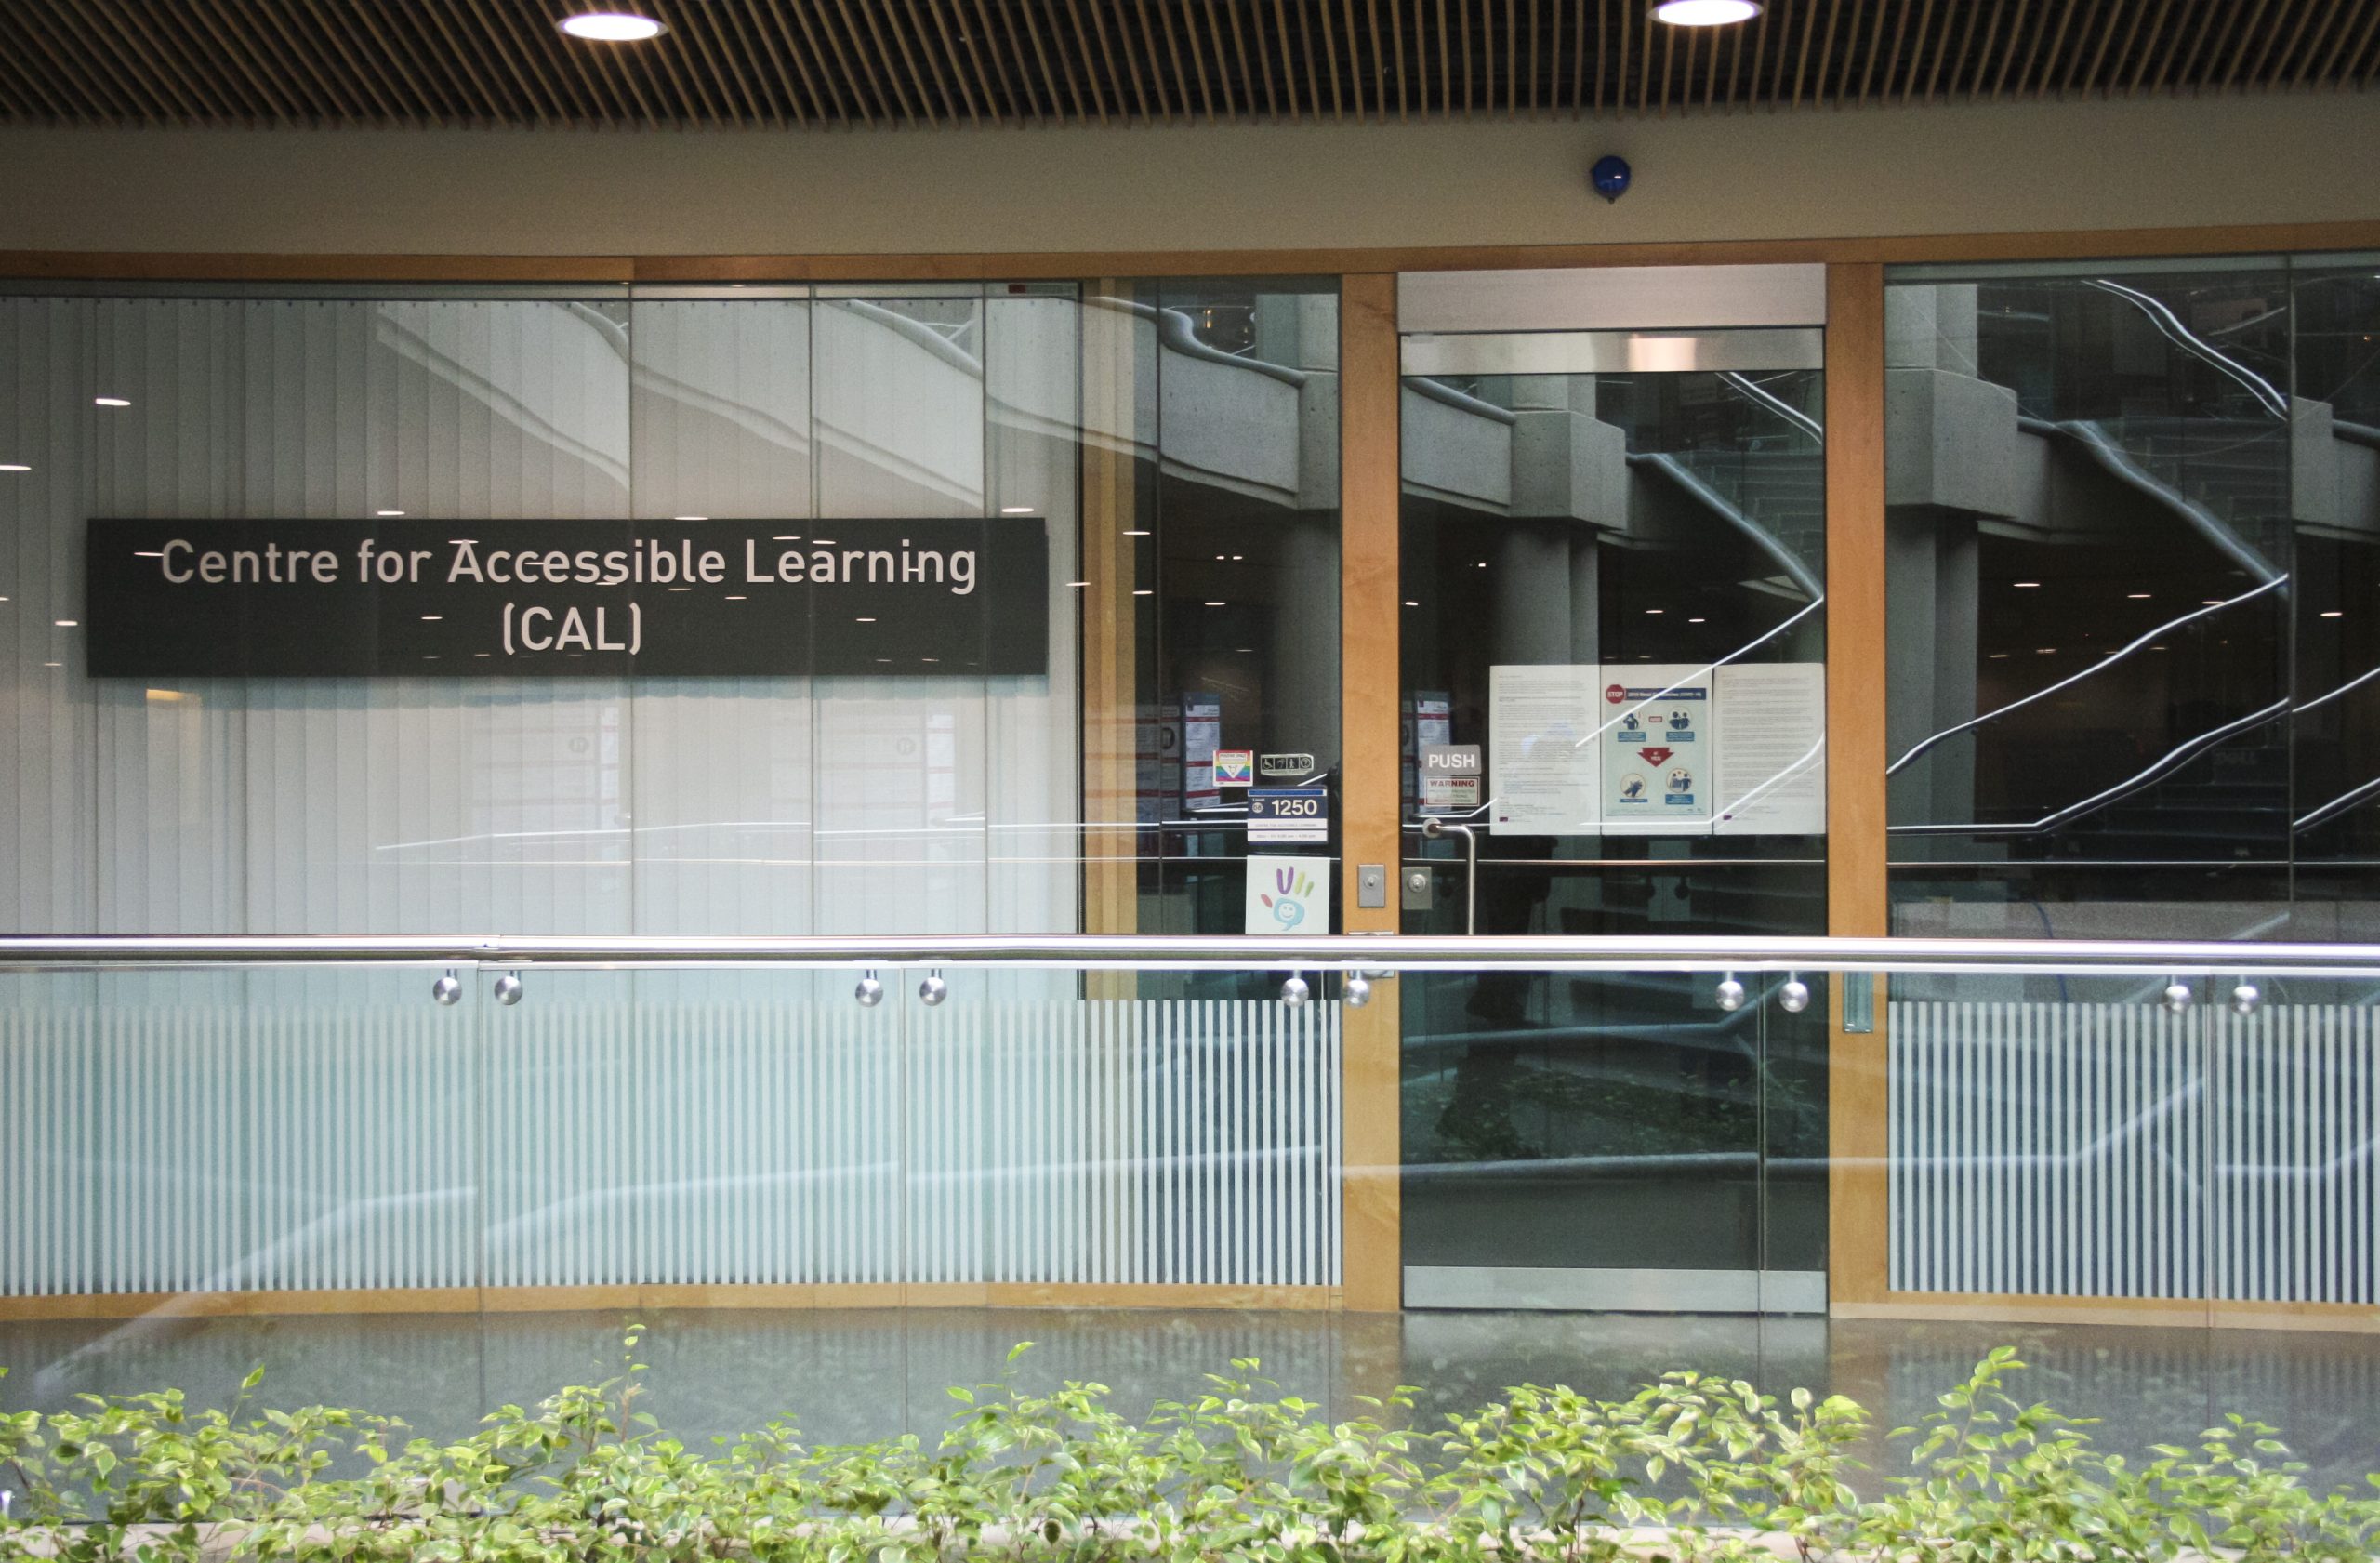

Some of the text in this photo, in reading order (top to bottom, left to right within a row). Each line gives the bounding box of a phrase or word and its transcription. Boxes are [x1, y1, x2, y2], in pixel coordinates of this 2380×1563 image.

[161, 538, 976, 596] Centre for Accessible Learning
[503, 602, 641, 656] (CAL)
[1428, 754, 1475, 768] PUSH
[1430, 779, 1475, 788] WARNING
[1271, 799, 1318, 815] 1250
